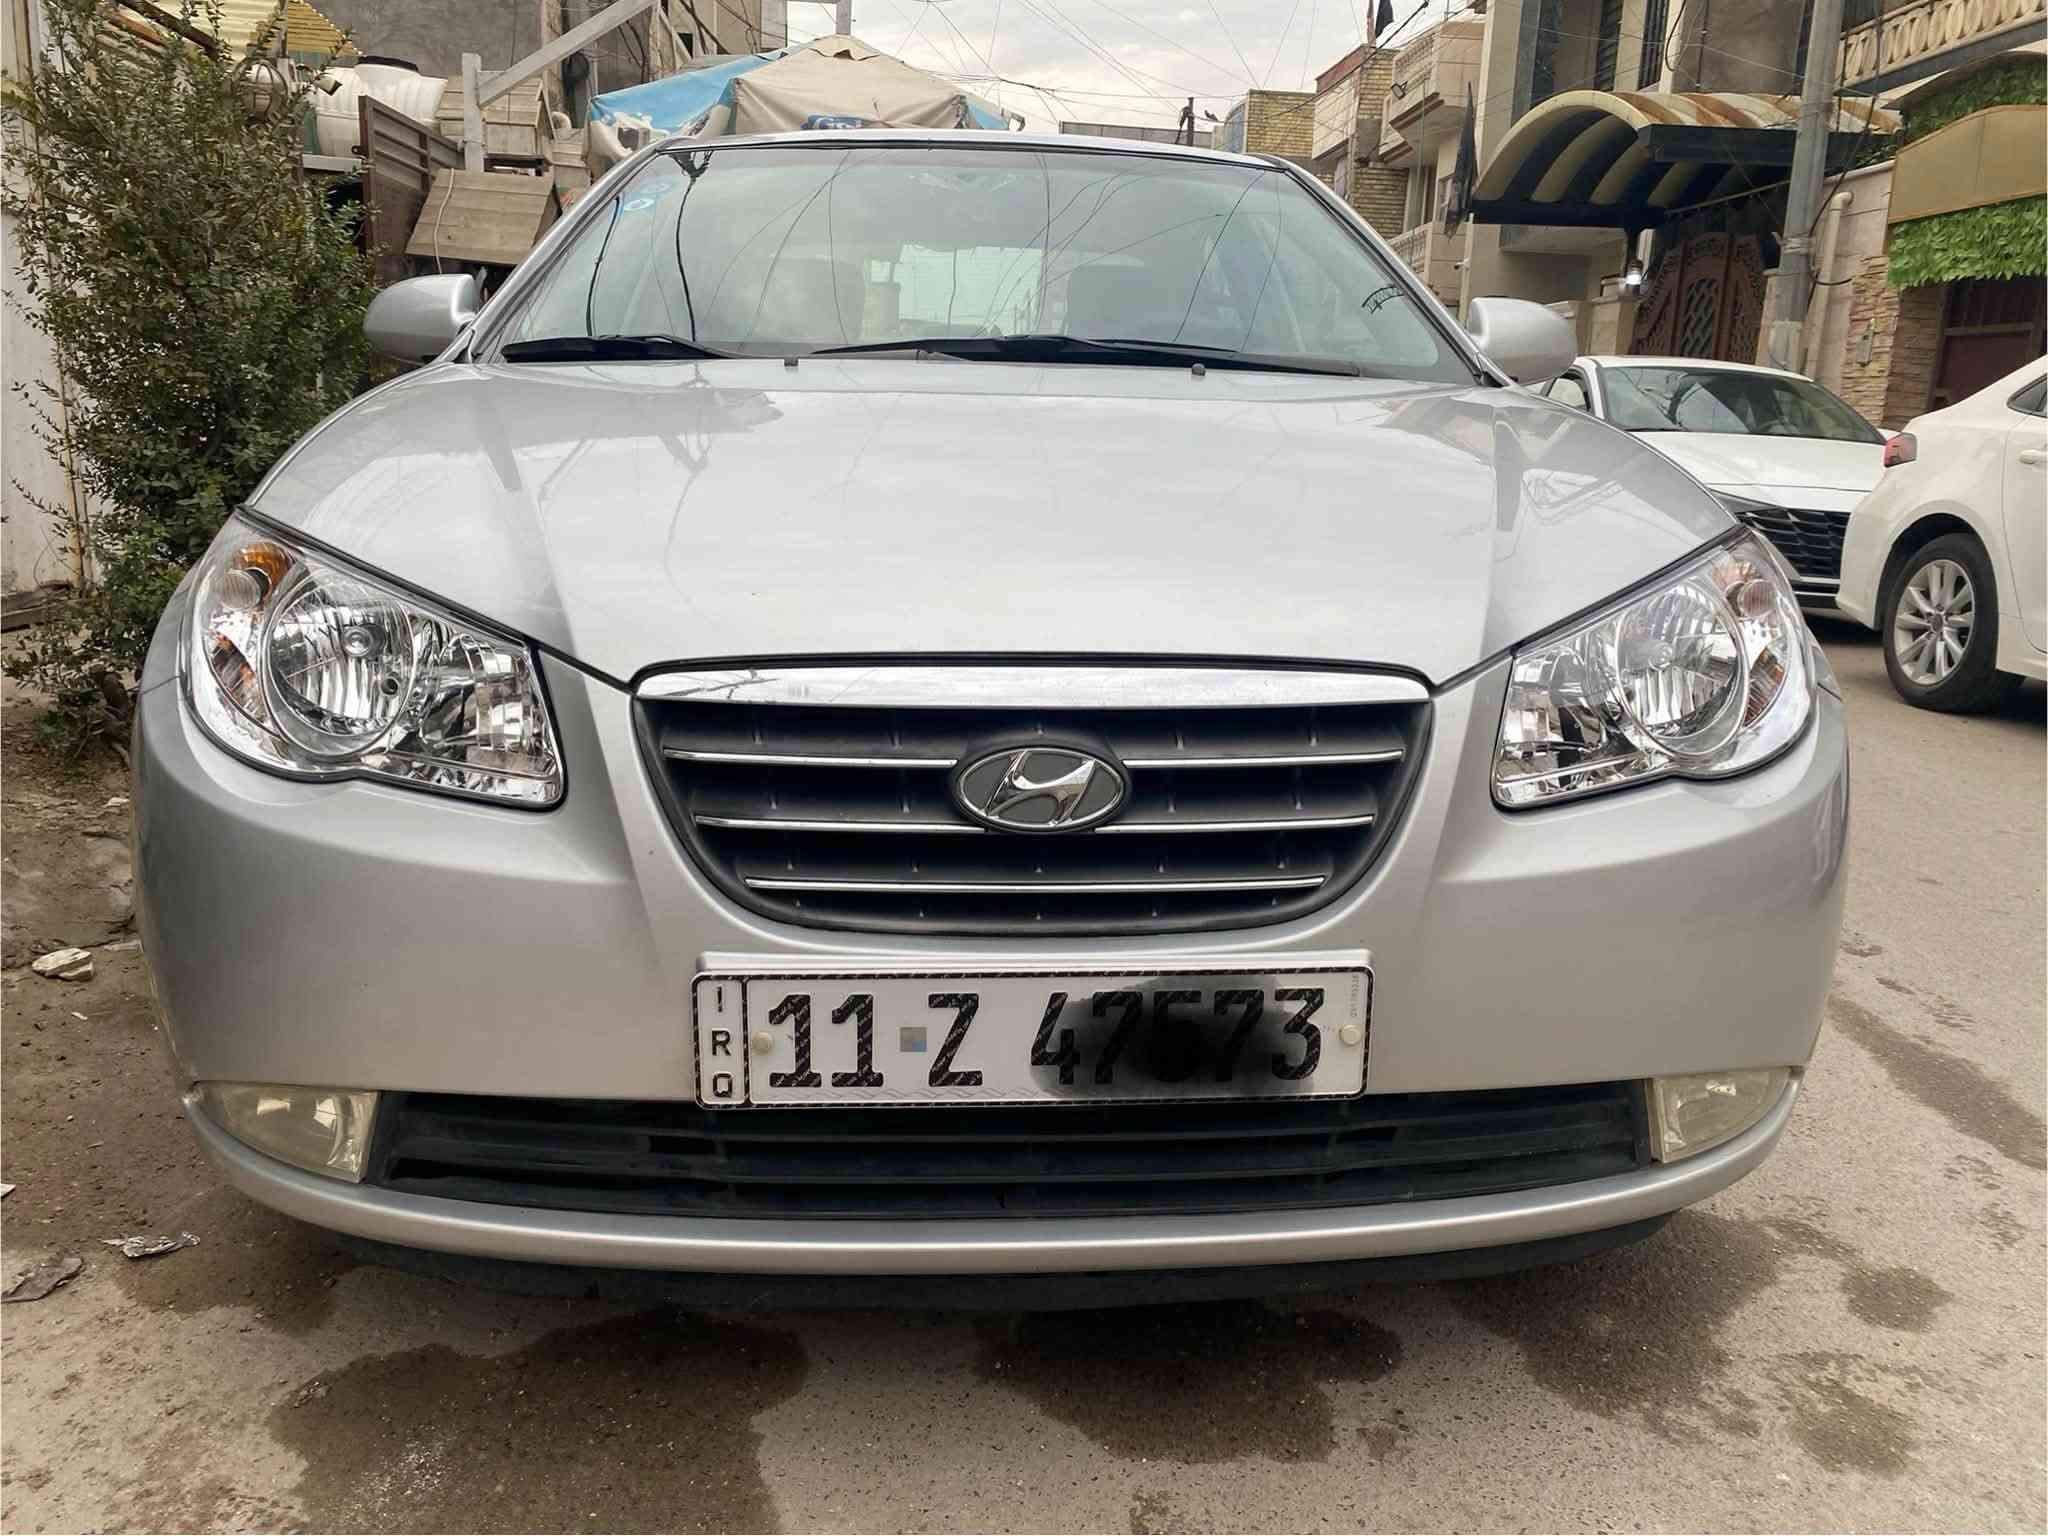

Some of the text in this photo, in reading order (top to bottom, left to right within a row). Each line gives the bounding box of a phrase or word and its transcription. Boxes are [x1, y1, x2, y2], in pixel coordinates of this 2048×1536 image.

[711, 986, 734, 1099] IRQ
[769, 994, 884, 1088] 11
[928, 993, 983, 1087] Z
